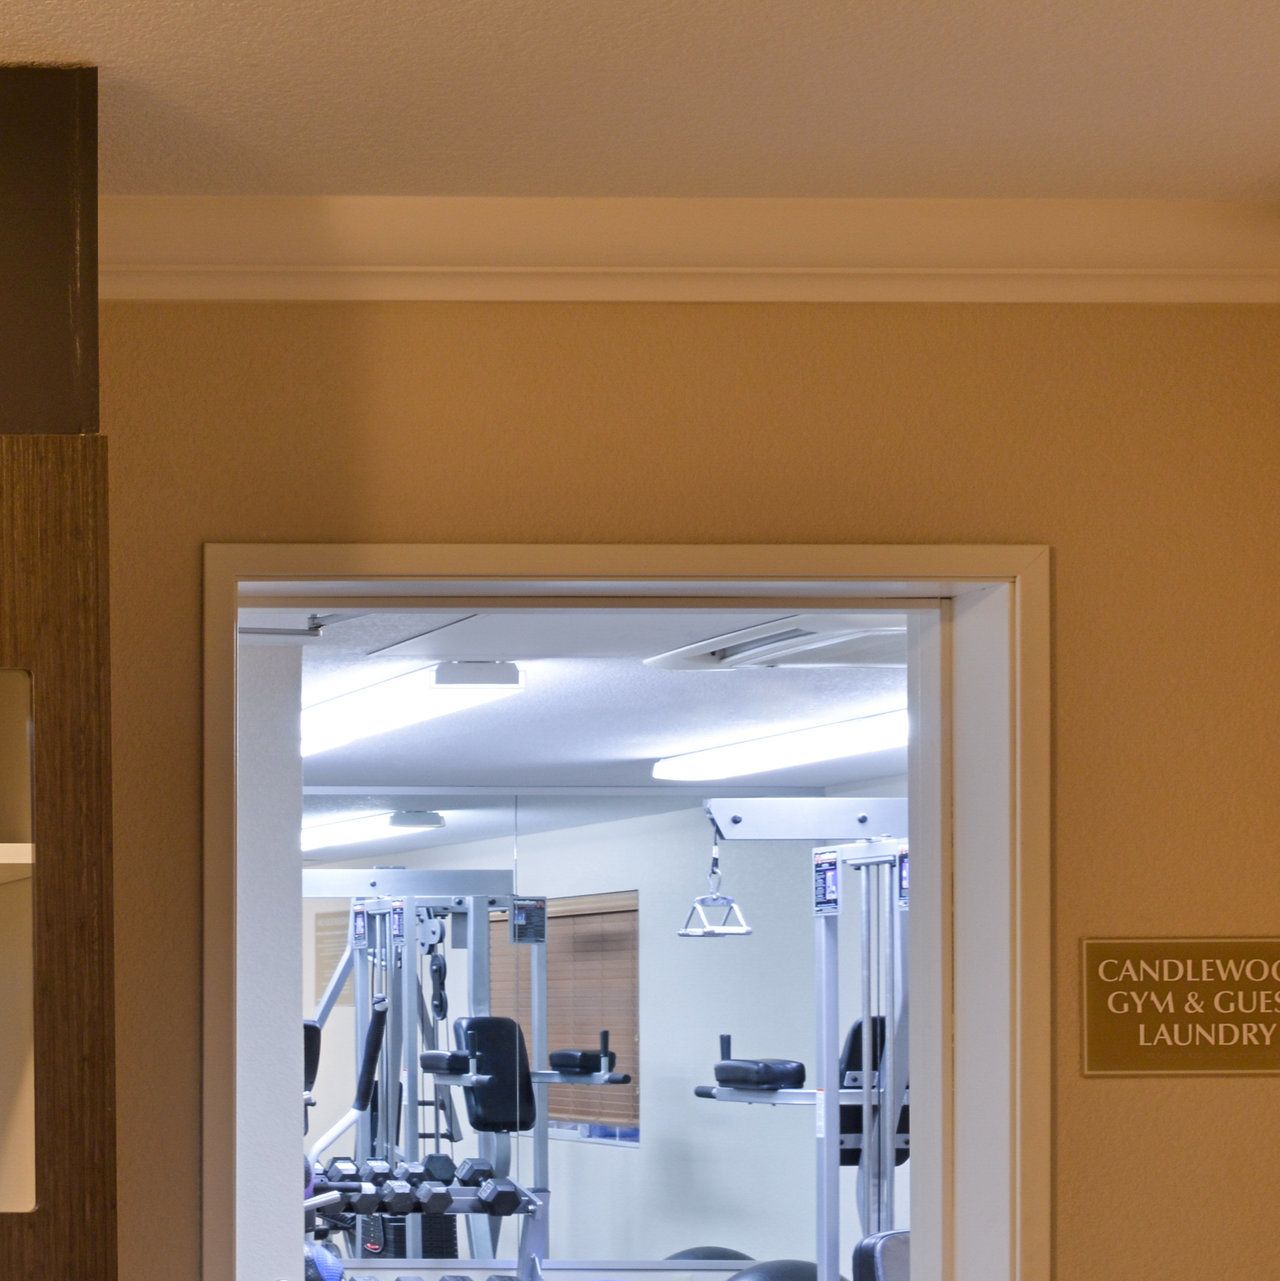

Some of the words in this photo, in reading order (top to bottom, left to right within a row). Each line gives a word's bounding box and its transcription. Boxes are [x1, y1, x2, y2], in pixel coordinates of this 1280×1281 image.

[1108, 991, 1175, 1014] GYM
[1184, 992, 1204, 1013] &
[1139, 1023, 1277, 1046] LAUNDRY
